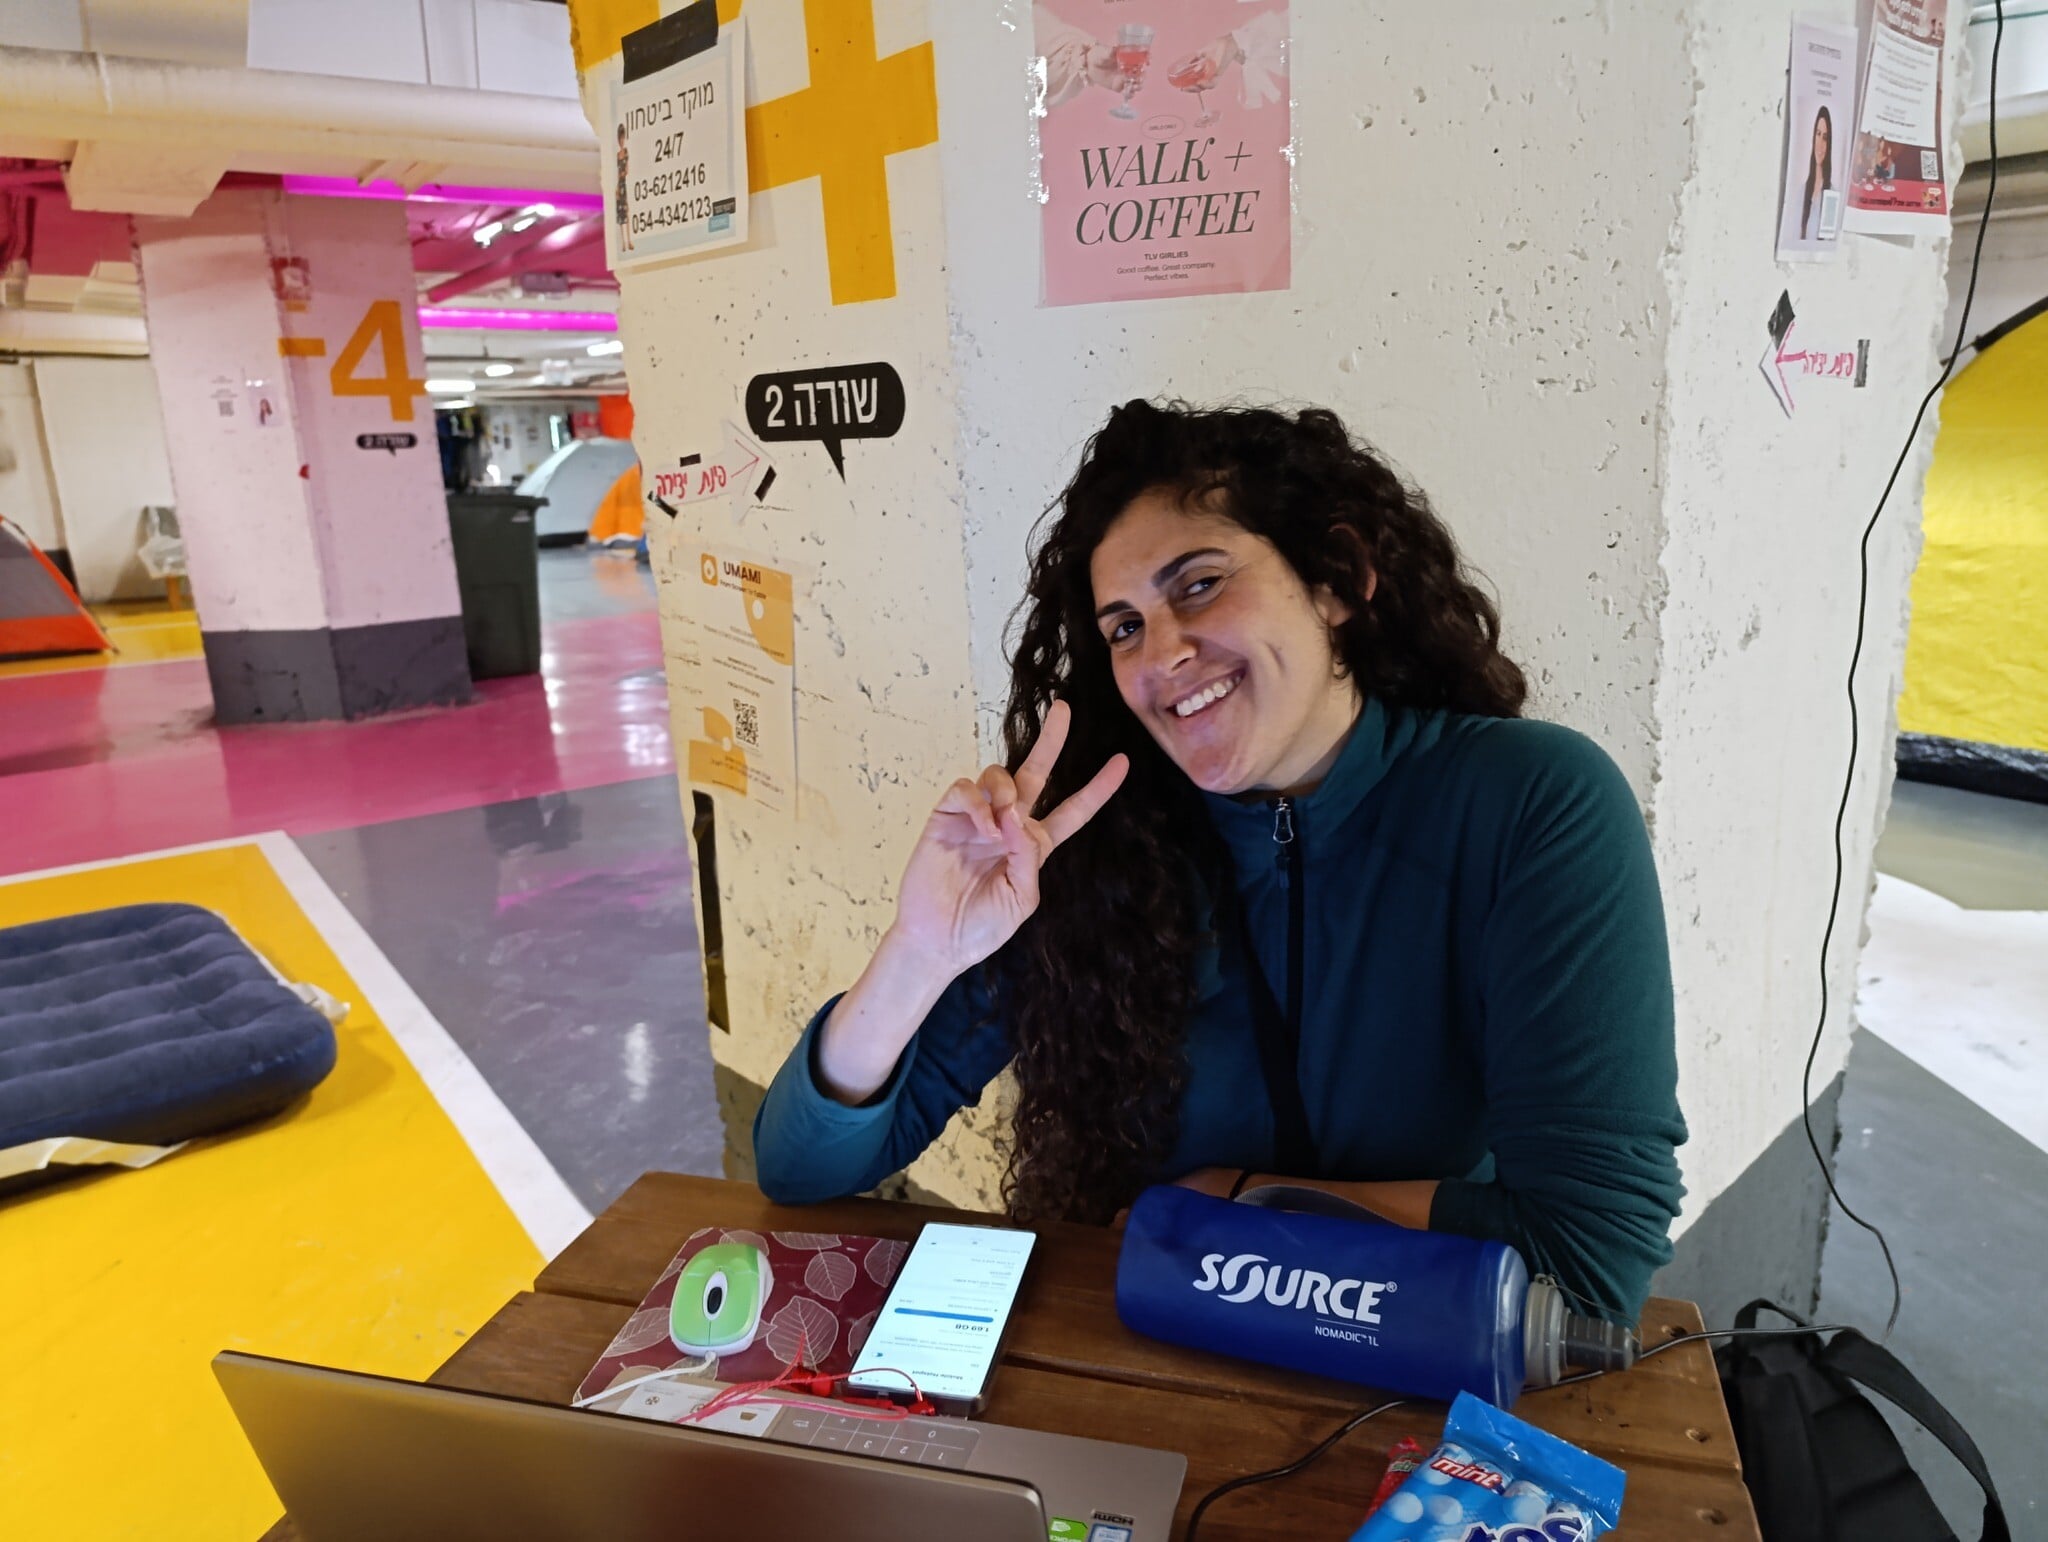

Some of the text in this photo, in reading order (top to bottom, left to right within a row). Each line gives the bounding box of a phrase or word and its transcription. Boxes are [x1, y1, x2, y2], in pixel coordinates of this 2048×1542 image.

[626, 81, 714, 140] מוקד ביטחון
[654, 131, 684, 163] 24/7
[1080, 137, 1253, 190] WALK +
[634, 162, 706, 202] 03-6212416
[632, 195, 712, 234] 054-4342123
[1076, 190, 1261, 246] COFFEE
[1116, 266, 1137, 275] Good
[1162, 263, 1181, 272] Great
[1143, 250, 1190, 261] TLV GIRLIES
[1144, 272, 1168, 282] Perfect
[277, 300, 427, 422] -4
[765, 378, 878, 427] שורה 2
[655, 465, 727, 499] פינת יצירה
[723, 561, 761, 585] UMAMI
[1368, 1335, 1380, 1347] 1L
[1430, 1458, 1503, 1490] mint
[1093, 1512, 1135, 1526] HDMI
